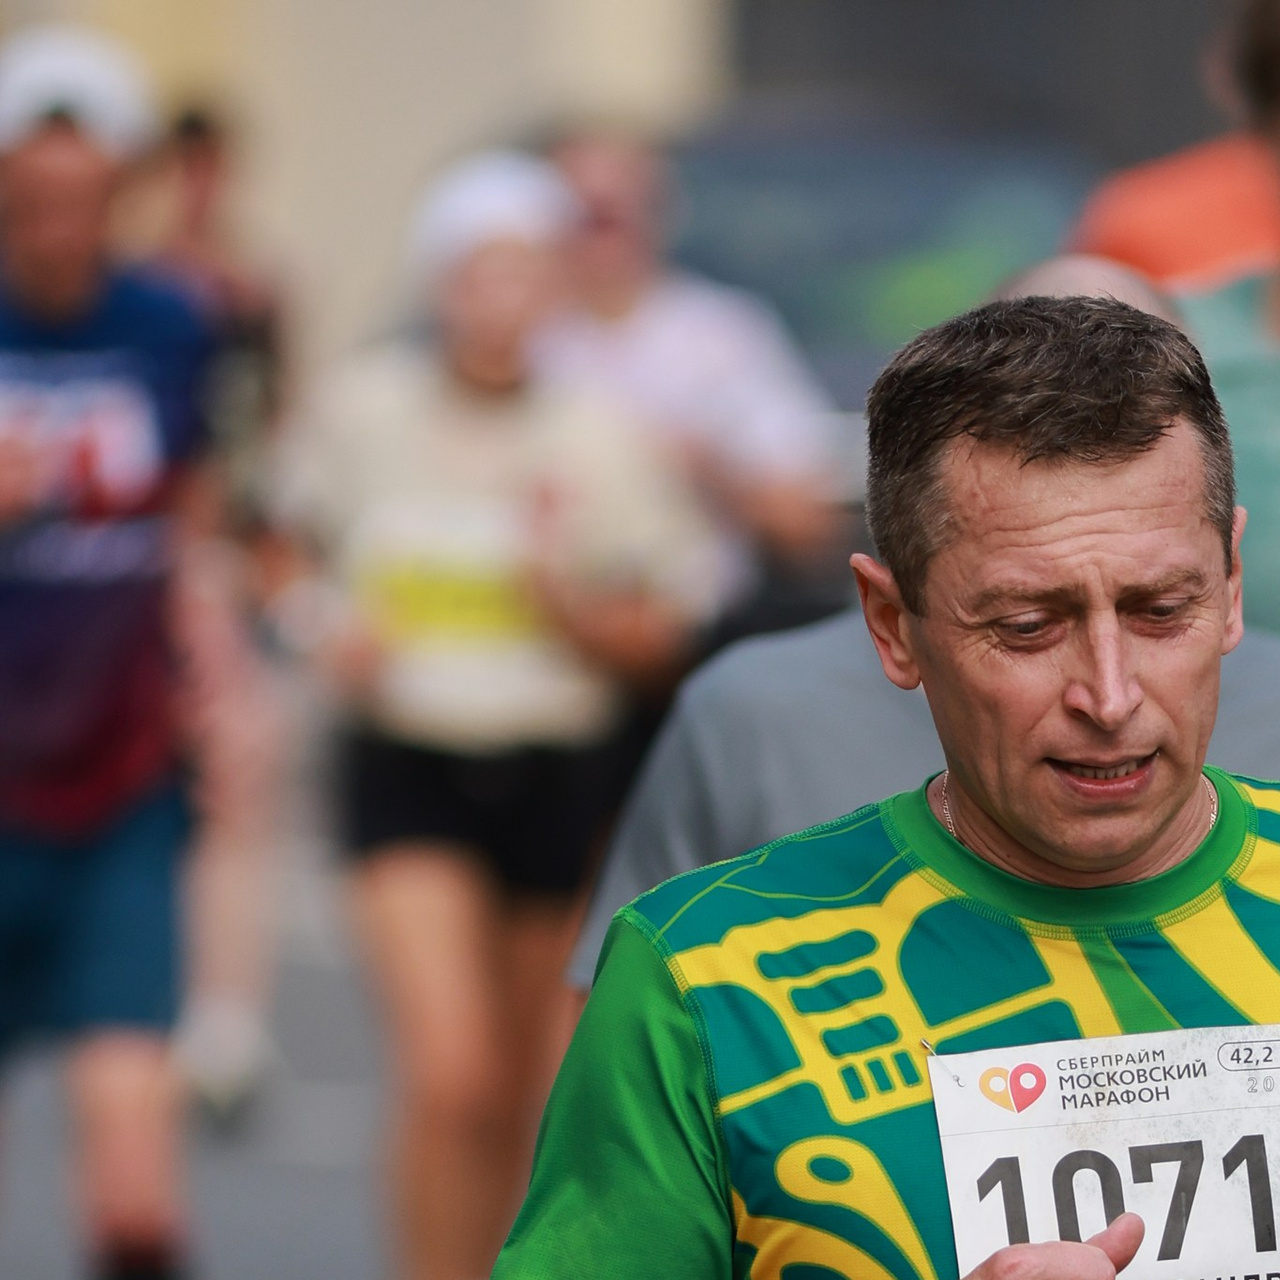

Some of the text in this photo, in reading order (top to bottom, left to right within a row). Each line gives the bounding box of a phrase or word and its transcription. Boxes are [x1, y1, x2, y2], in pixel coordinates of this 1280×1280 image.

[1056, 1048, 1166, 1071] СБЕРПРАЙМ
[1229, 1046, 1274, 1066] 42,2
[1058, 1058, 1208, 1091] МОСКОВСКИЙ
[1061, 1085, 1171, 1110] МАРАФОН
